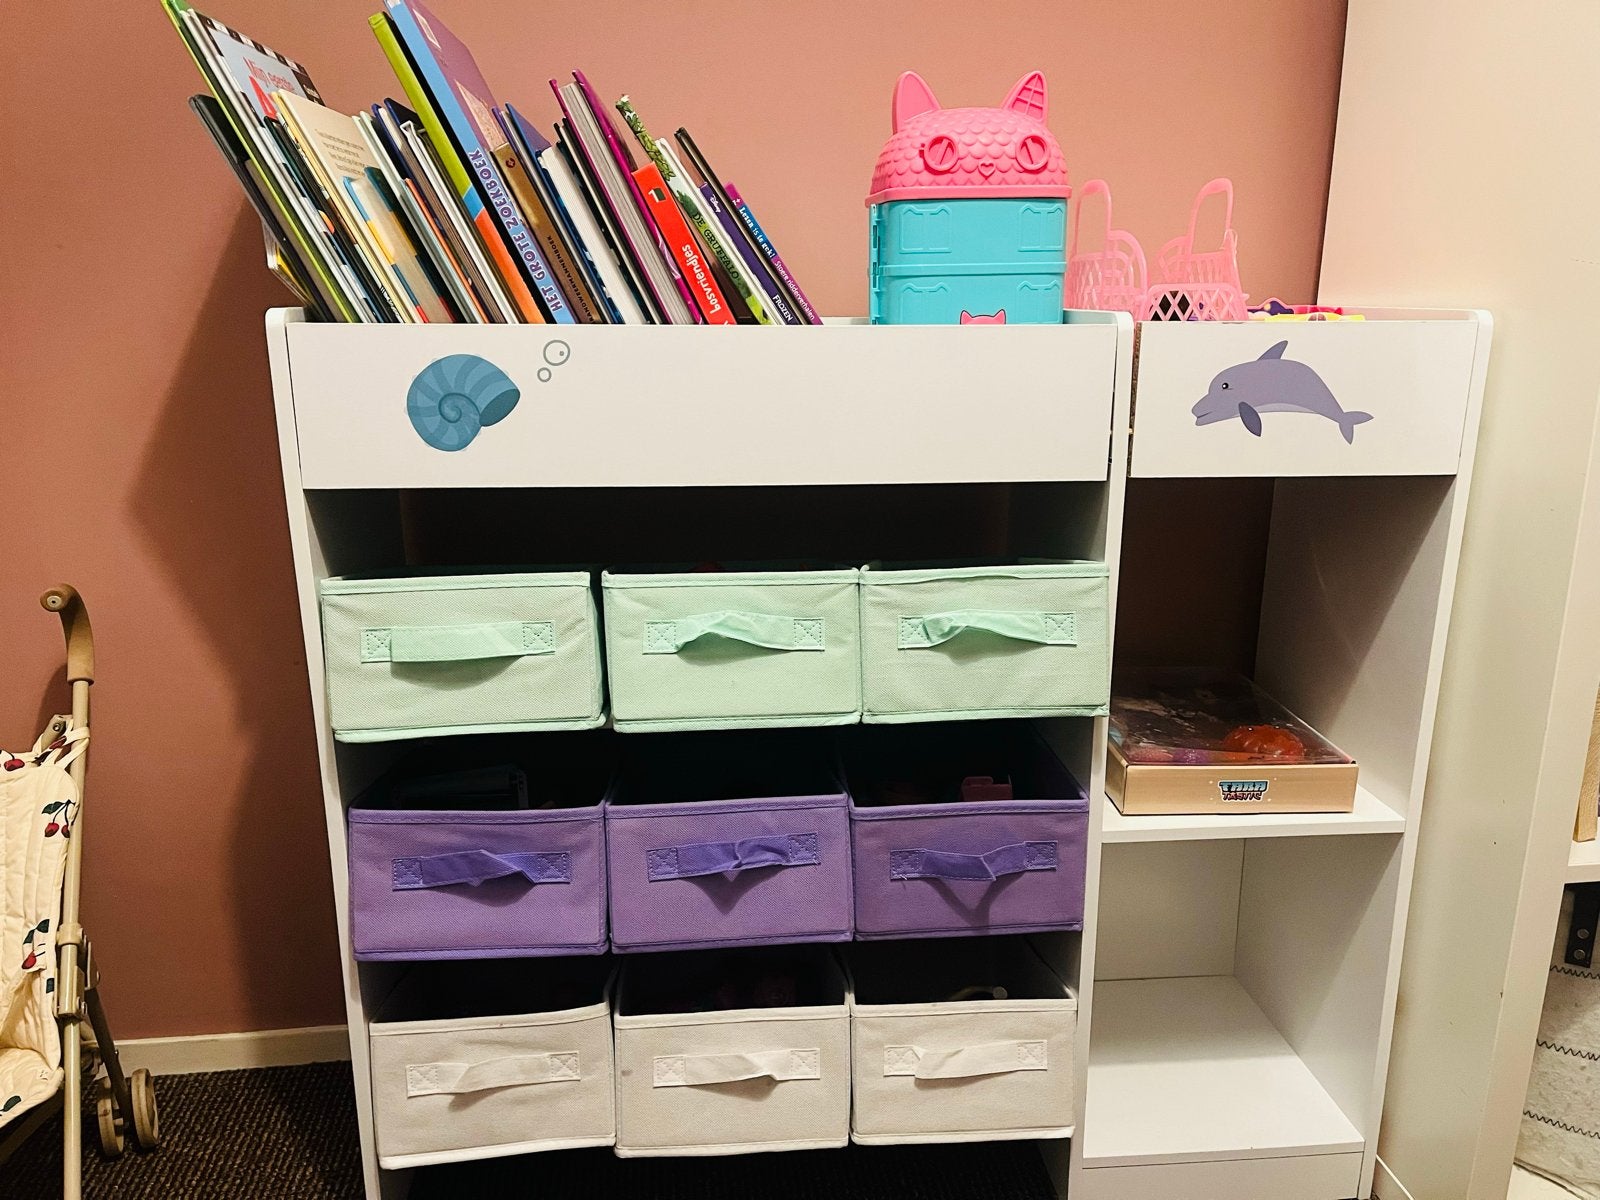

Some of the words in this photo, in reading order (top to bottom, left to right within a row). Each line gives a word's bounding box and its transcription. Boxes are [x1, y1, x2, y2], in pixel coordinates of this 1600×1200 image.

[468, 148, 519, 229] ZOEKBOEK
[513, 232, 545, 281] GROTE
[693, 213, 706, 228] DE
[703, 229, 739, 279] GRUFFALO
[541, 284, 563, 312] HET
[682, 244, 721, 314] bosvriendjes
[772, 294, 794, 322] FROZEN
[774, 260, 789, 281] Stoere
[787, 279, 815, 321] ridderverhalen
